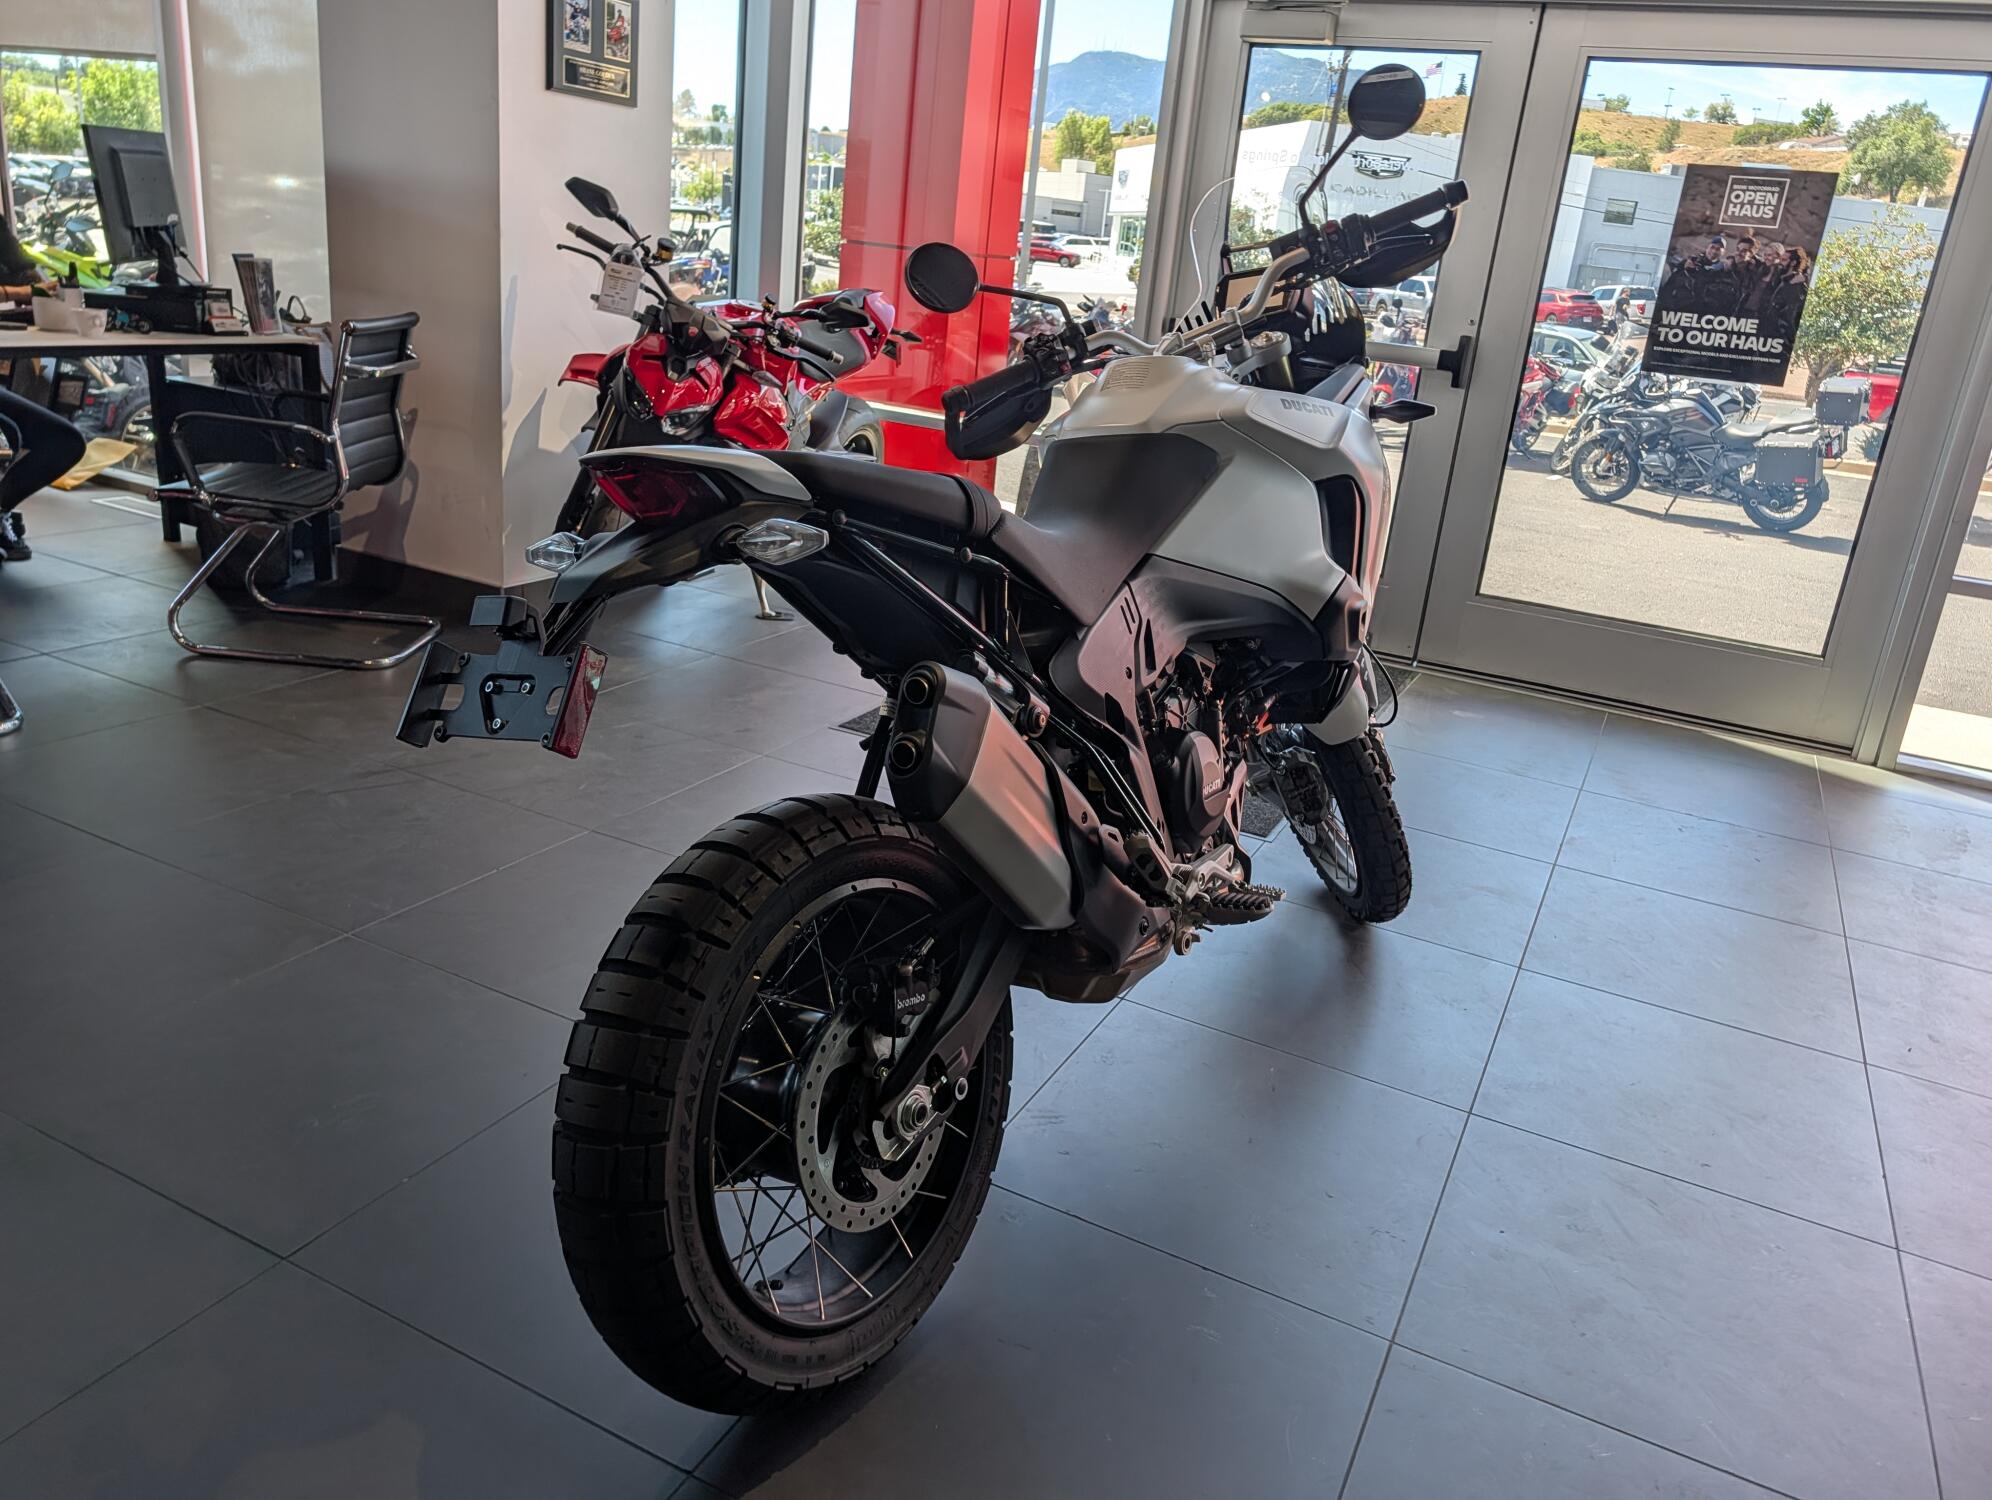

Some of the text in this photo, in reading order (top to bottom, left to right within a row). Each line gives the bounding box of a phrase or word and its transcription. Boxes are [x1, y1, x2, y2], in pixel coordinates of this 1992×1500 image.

[1730, 190, 1779, 206] OPEN
[1727, 203, 1775, 219] HAUS
[1661, 310, 1760, 334] WELCOME
[1657, 327, 1785, 354] TO OUR HAUS
[1280, 398, 1335, 418] DUCATI
[896, 992, 926, 1011] brembo
